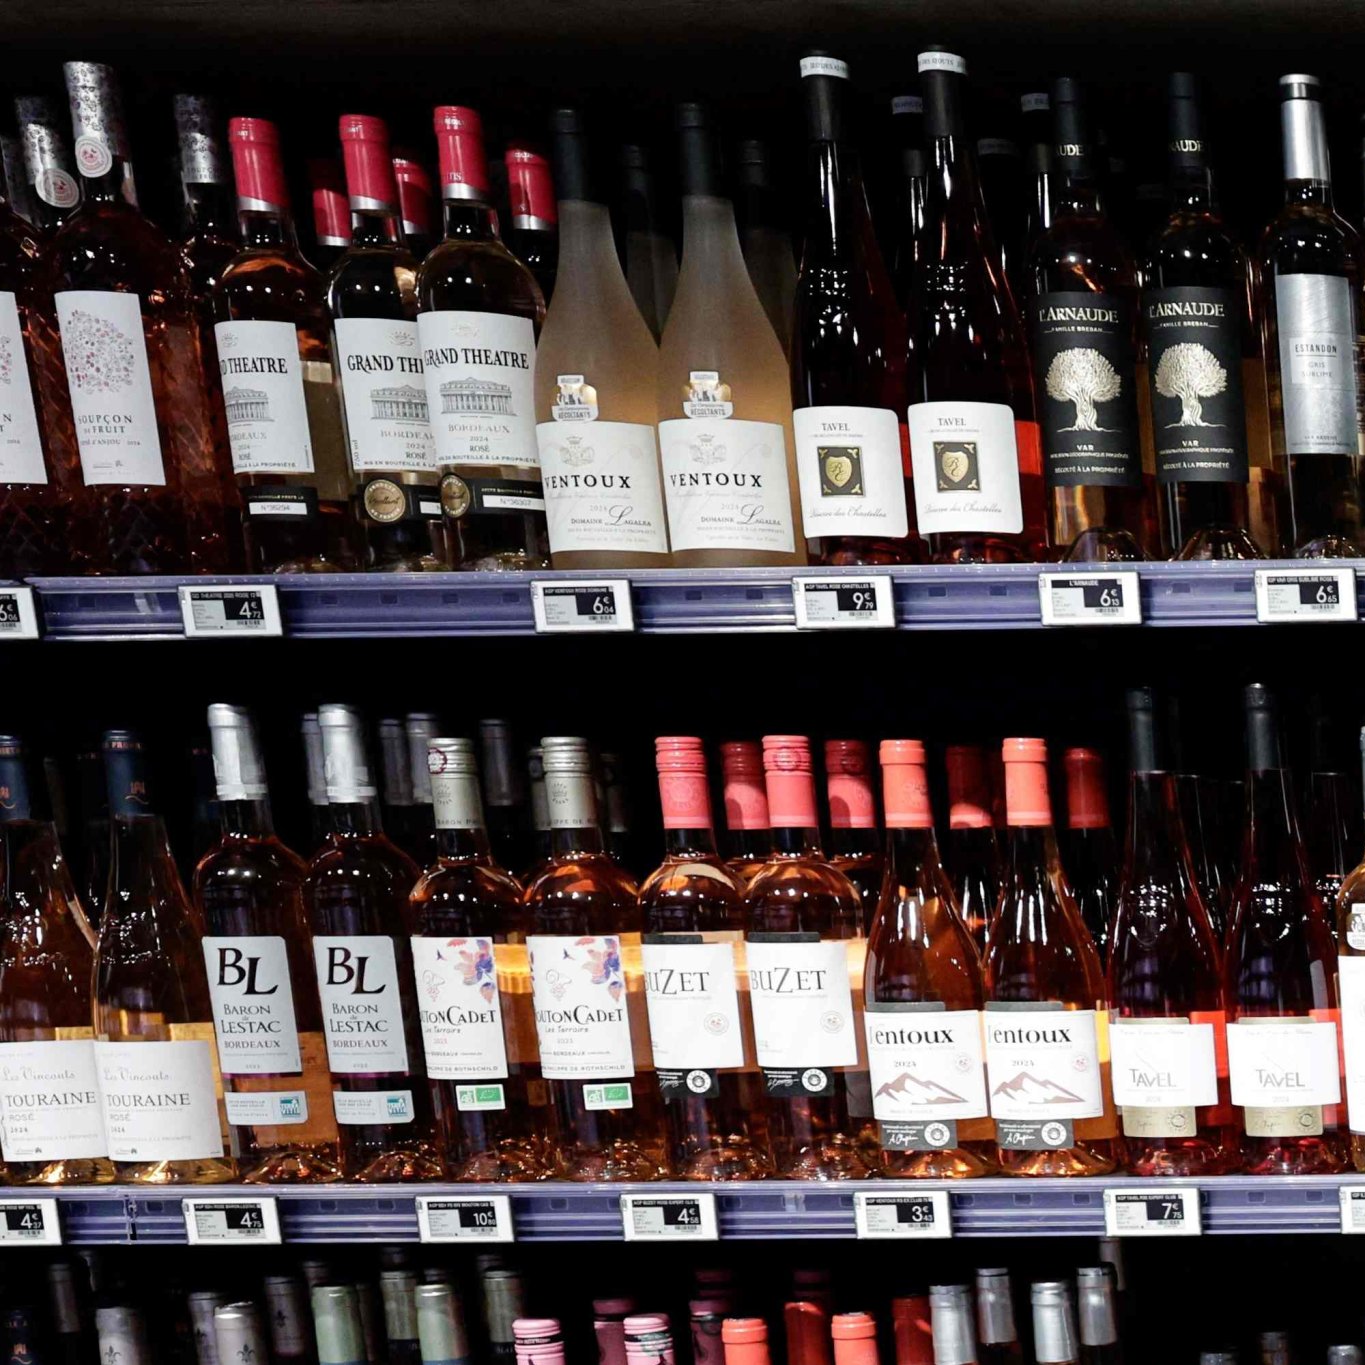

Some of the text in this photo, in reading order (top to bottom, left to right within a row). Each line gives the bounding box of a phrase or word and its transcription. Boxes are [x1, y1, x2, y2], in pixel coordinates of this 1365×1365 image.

[1039, 308, 1118, 324] L'ARNAUDE
[1295, 344, 1338, 356] ESTANDON
[228, 356, 287, 375] THEATRE
[347, 355, 391, 373] GRAND
[458, 348, 529, 370] THEATRE
[92, 425, 125, 435] FRUIT
[821, 422, 850, 432] TAVEL
[469, 443, 490, 453] ROSÉ
[1076, 444, 1094, 452] VAR
[543, 473, 631, 490] VENTOUX
[669, 473, 763, 489] VENTOUX
[217, 947, 277, 997] BL
[1129, 1067, 1177, 1088] TAVEL
[107, 1093, 191, 1108] TOURAINE
